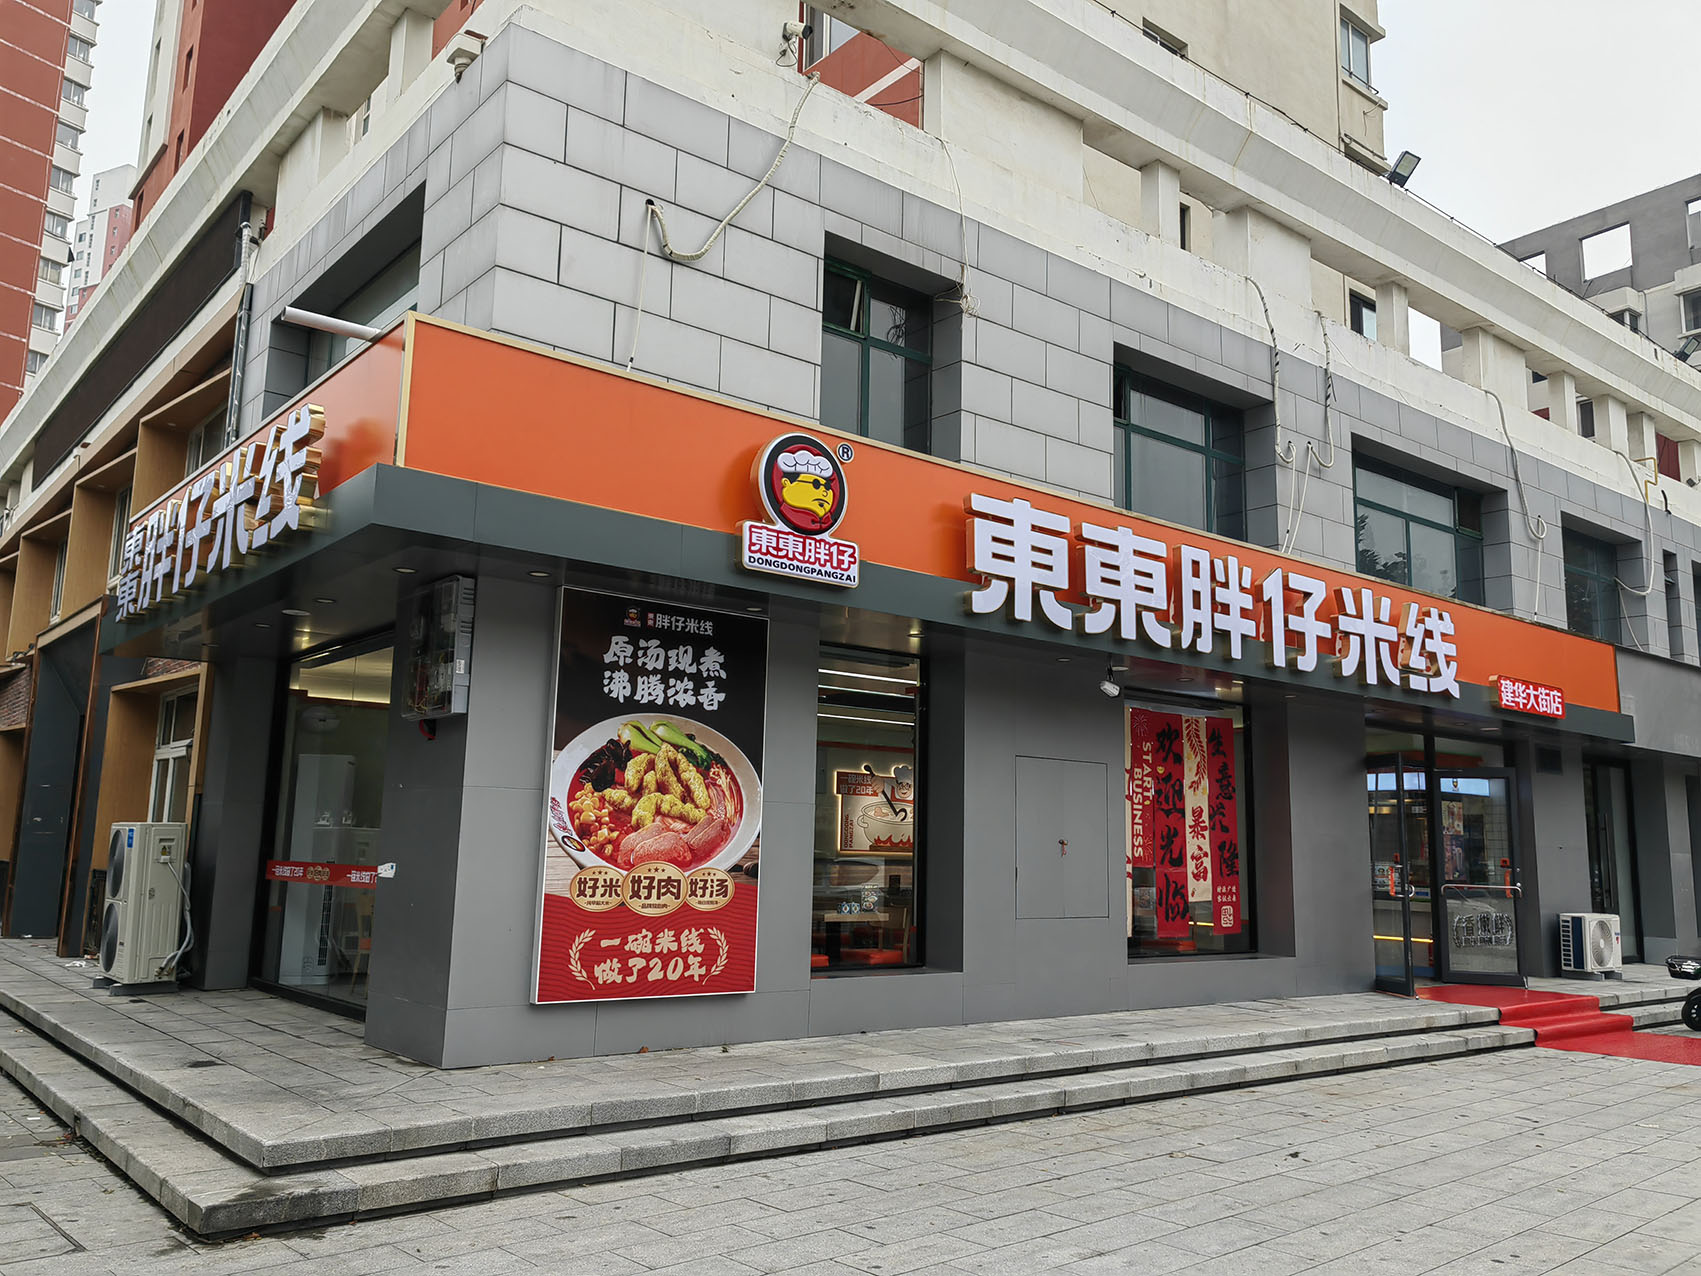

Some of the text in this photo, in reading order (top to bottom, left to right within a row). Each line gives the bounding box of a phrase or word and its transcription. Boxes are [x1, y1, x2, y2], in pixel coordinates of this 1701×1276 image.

[747, 555, 857, 583] DONGDONGPANGZAI
[749, 525, 857, 572] 東東胖仔
[966, 491, 1461, 700] 東東胖仔米线
[655, 613, 714, 637] 胖仔米线
[603, 635, 728, 681] 原汤现煮
[602, 669, 727, 712] 沸腾浓香
[1499, 678, 1563, 717] 建华大街店
[1133, 767, 1144, 859] BUSINESS
[1155, 721, 1190, 923] 欢迎光临
[1207, 727, 1240, 878] 生意兴隆
[1188, 805, 1210, 883] 暴富
[576, 877, 621, 899] 好米
[629, 875, 682, 901] 好肉
[688, 878, 728, 899] 好汤
[599, 927, 706, 956] 一碗米线
[593, 953, 707, 985] 做了20年
